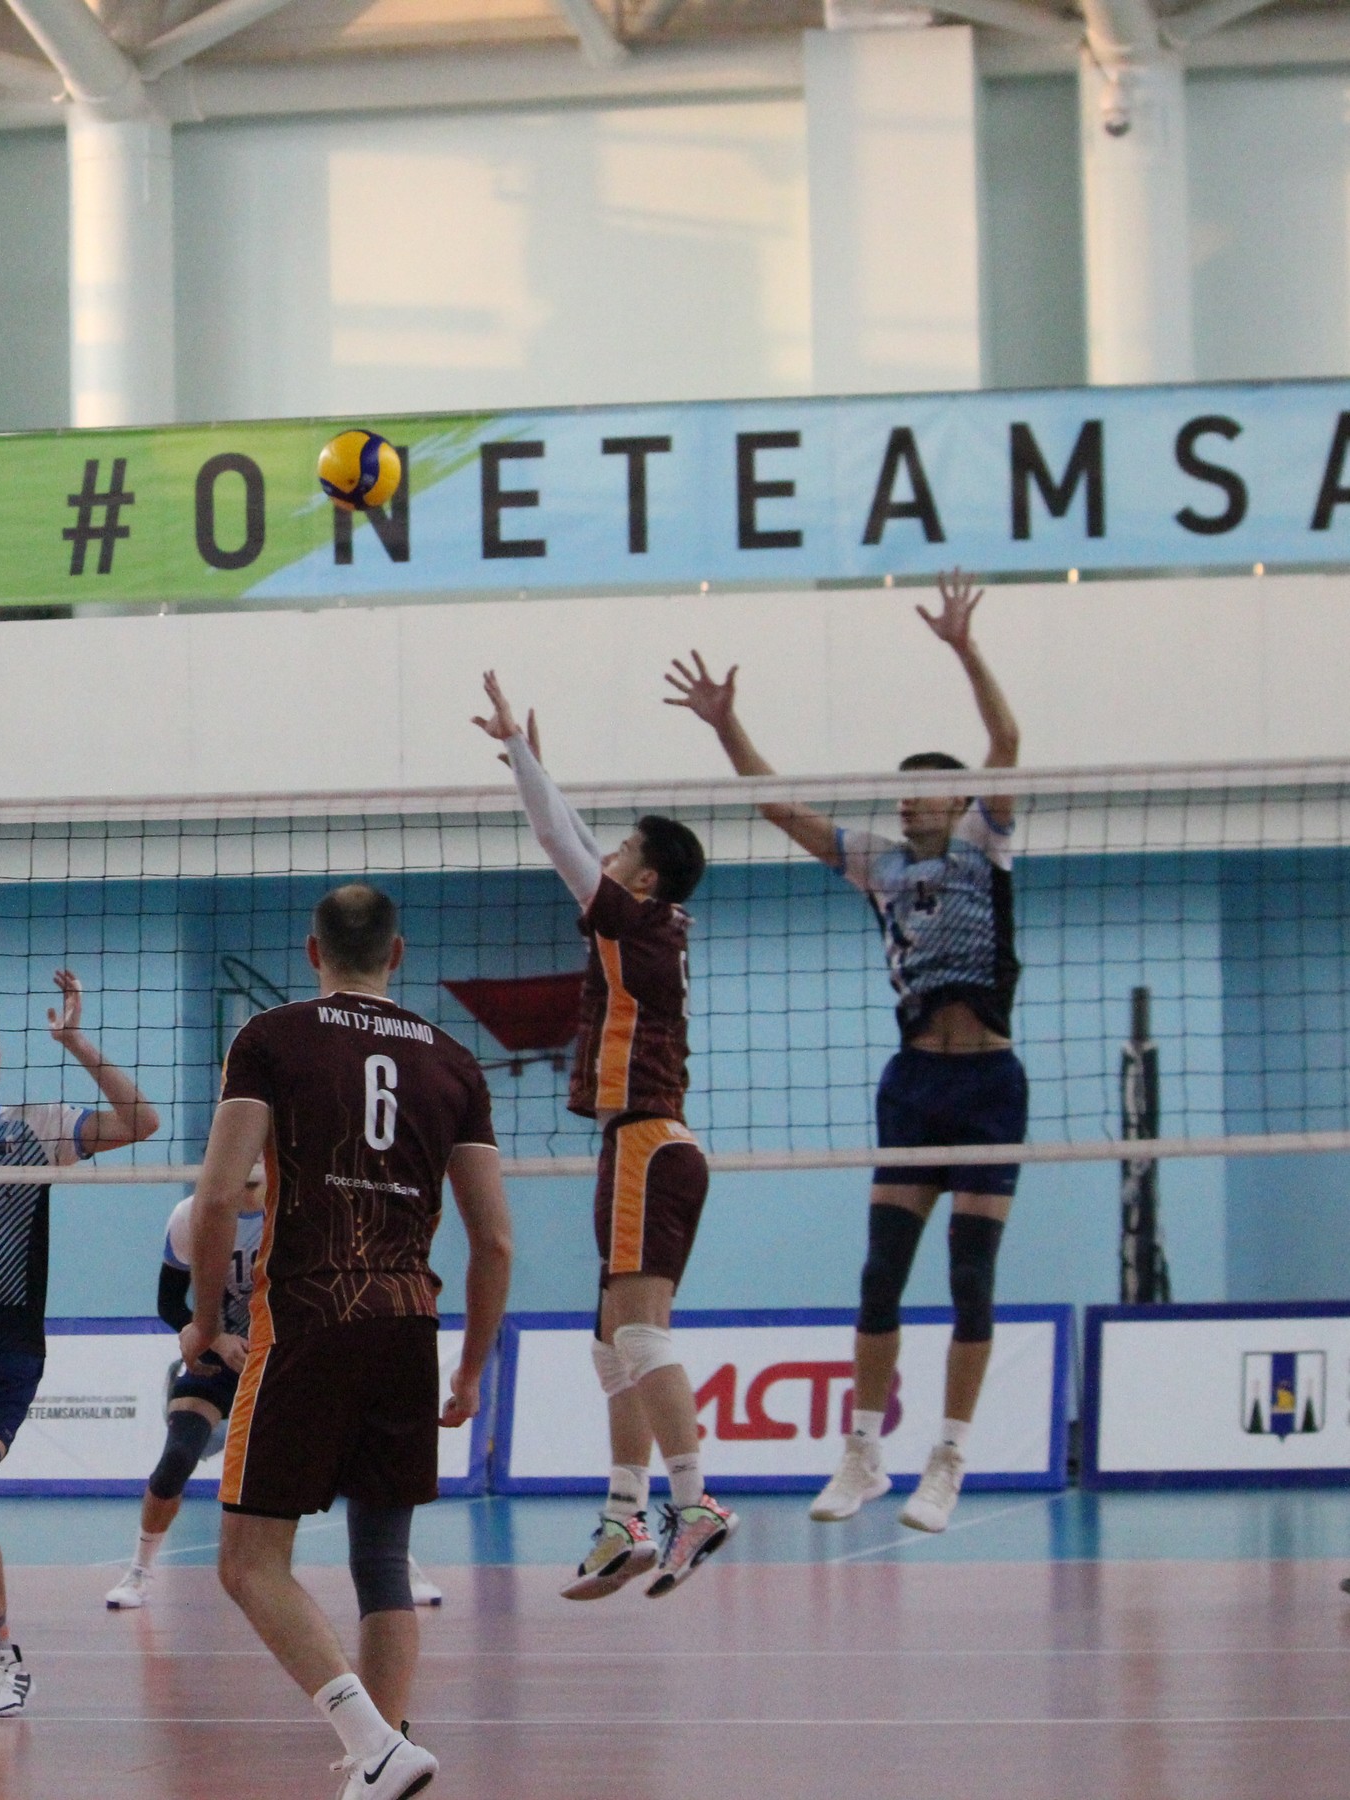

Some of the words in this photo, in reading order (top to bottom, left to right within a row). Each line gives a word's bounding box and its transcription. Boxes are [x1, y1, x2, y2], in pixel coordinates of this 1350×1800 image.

[317, 1006, 434, 1045] ИЖГТУ-ДИНАМО
[364, 1054, 398, 1151] 6
[325, 1173, 421, 1198] РоссельхозБанк
[26, 1406, 136, 1419] ETEAMSAKHALIN.COM
